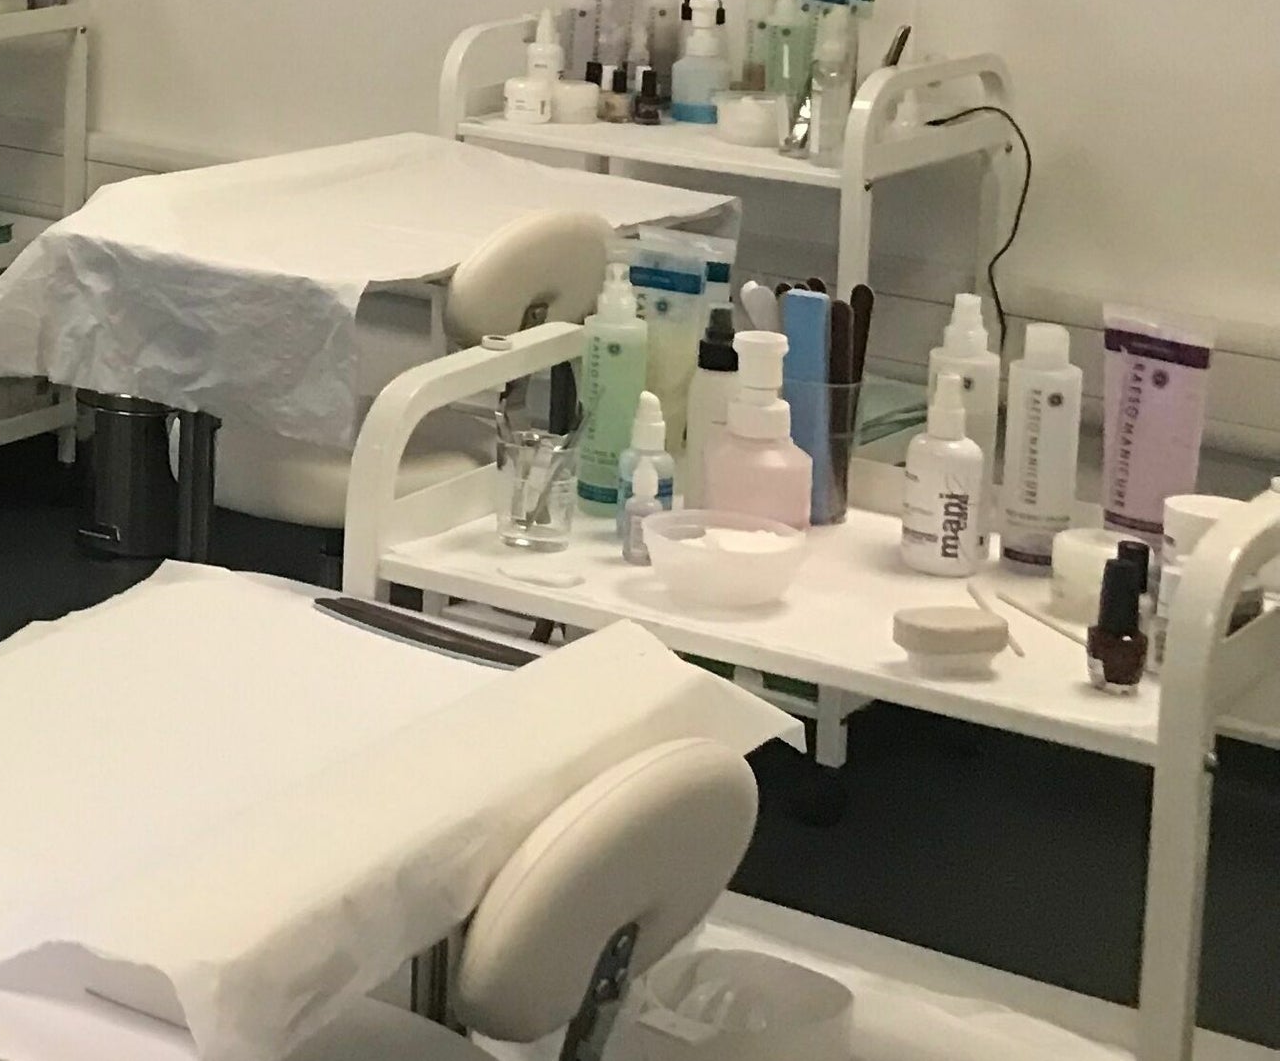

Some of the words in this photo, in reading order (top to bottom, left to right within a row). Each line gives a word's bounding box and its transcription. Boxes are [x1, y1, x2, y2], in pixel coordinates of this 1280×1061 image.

[1024, 436, 1038, 505] MANICURE
[1114, 422, 1135, 508] MANICURE
[939, 493, 963, 559] mani
